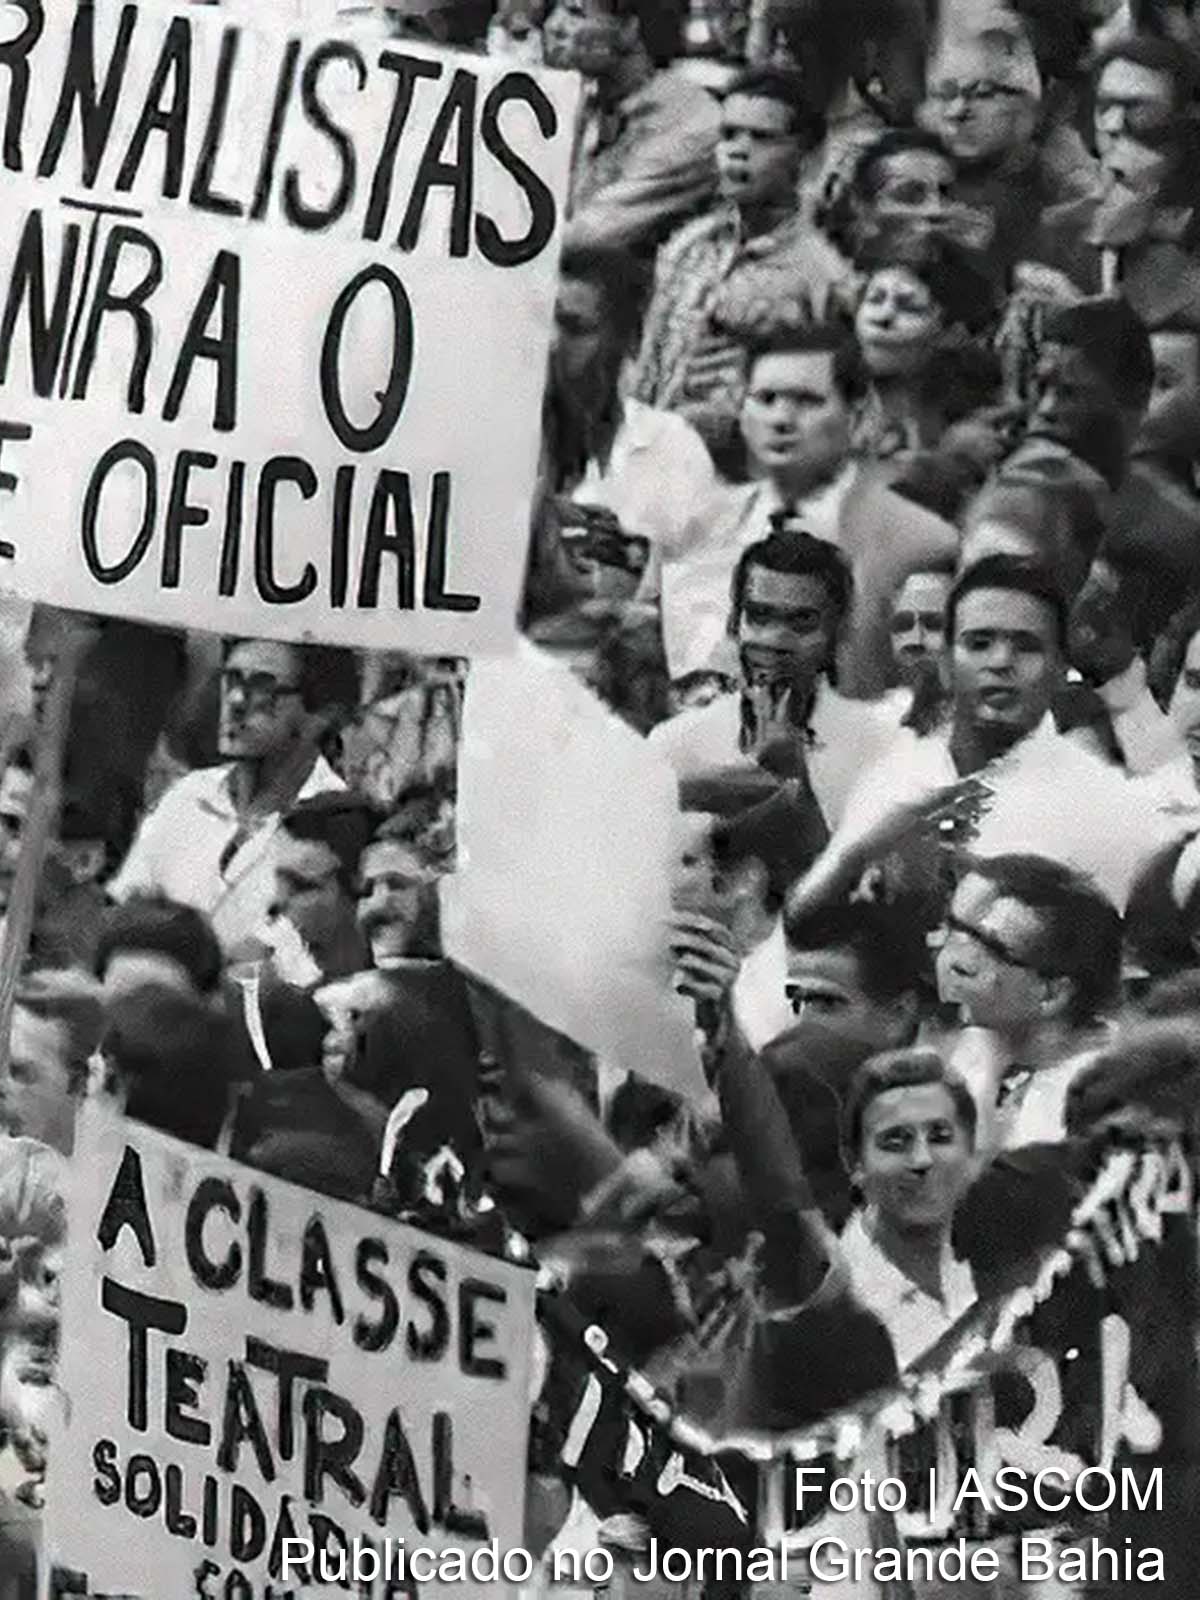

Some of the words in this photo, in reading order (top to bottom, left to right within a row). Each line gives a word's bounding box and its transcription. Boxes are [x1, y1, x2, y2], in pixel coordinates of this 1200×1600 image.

[81, 438, 481, 611] OFICIAL
[97, 1145, 155, 1267] A
[185, 1176, 507, 1380] CLASSE
[102, 1277, 490, 1541] TEATRAL
